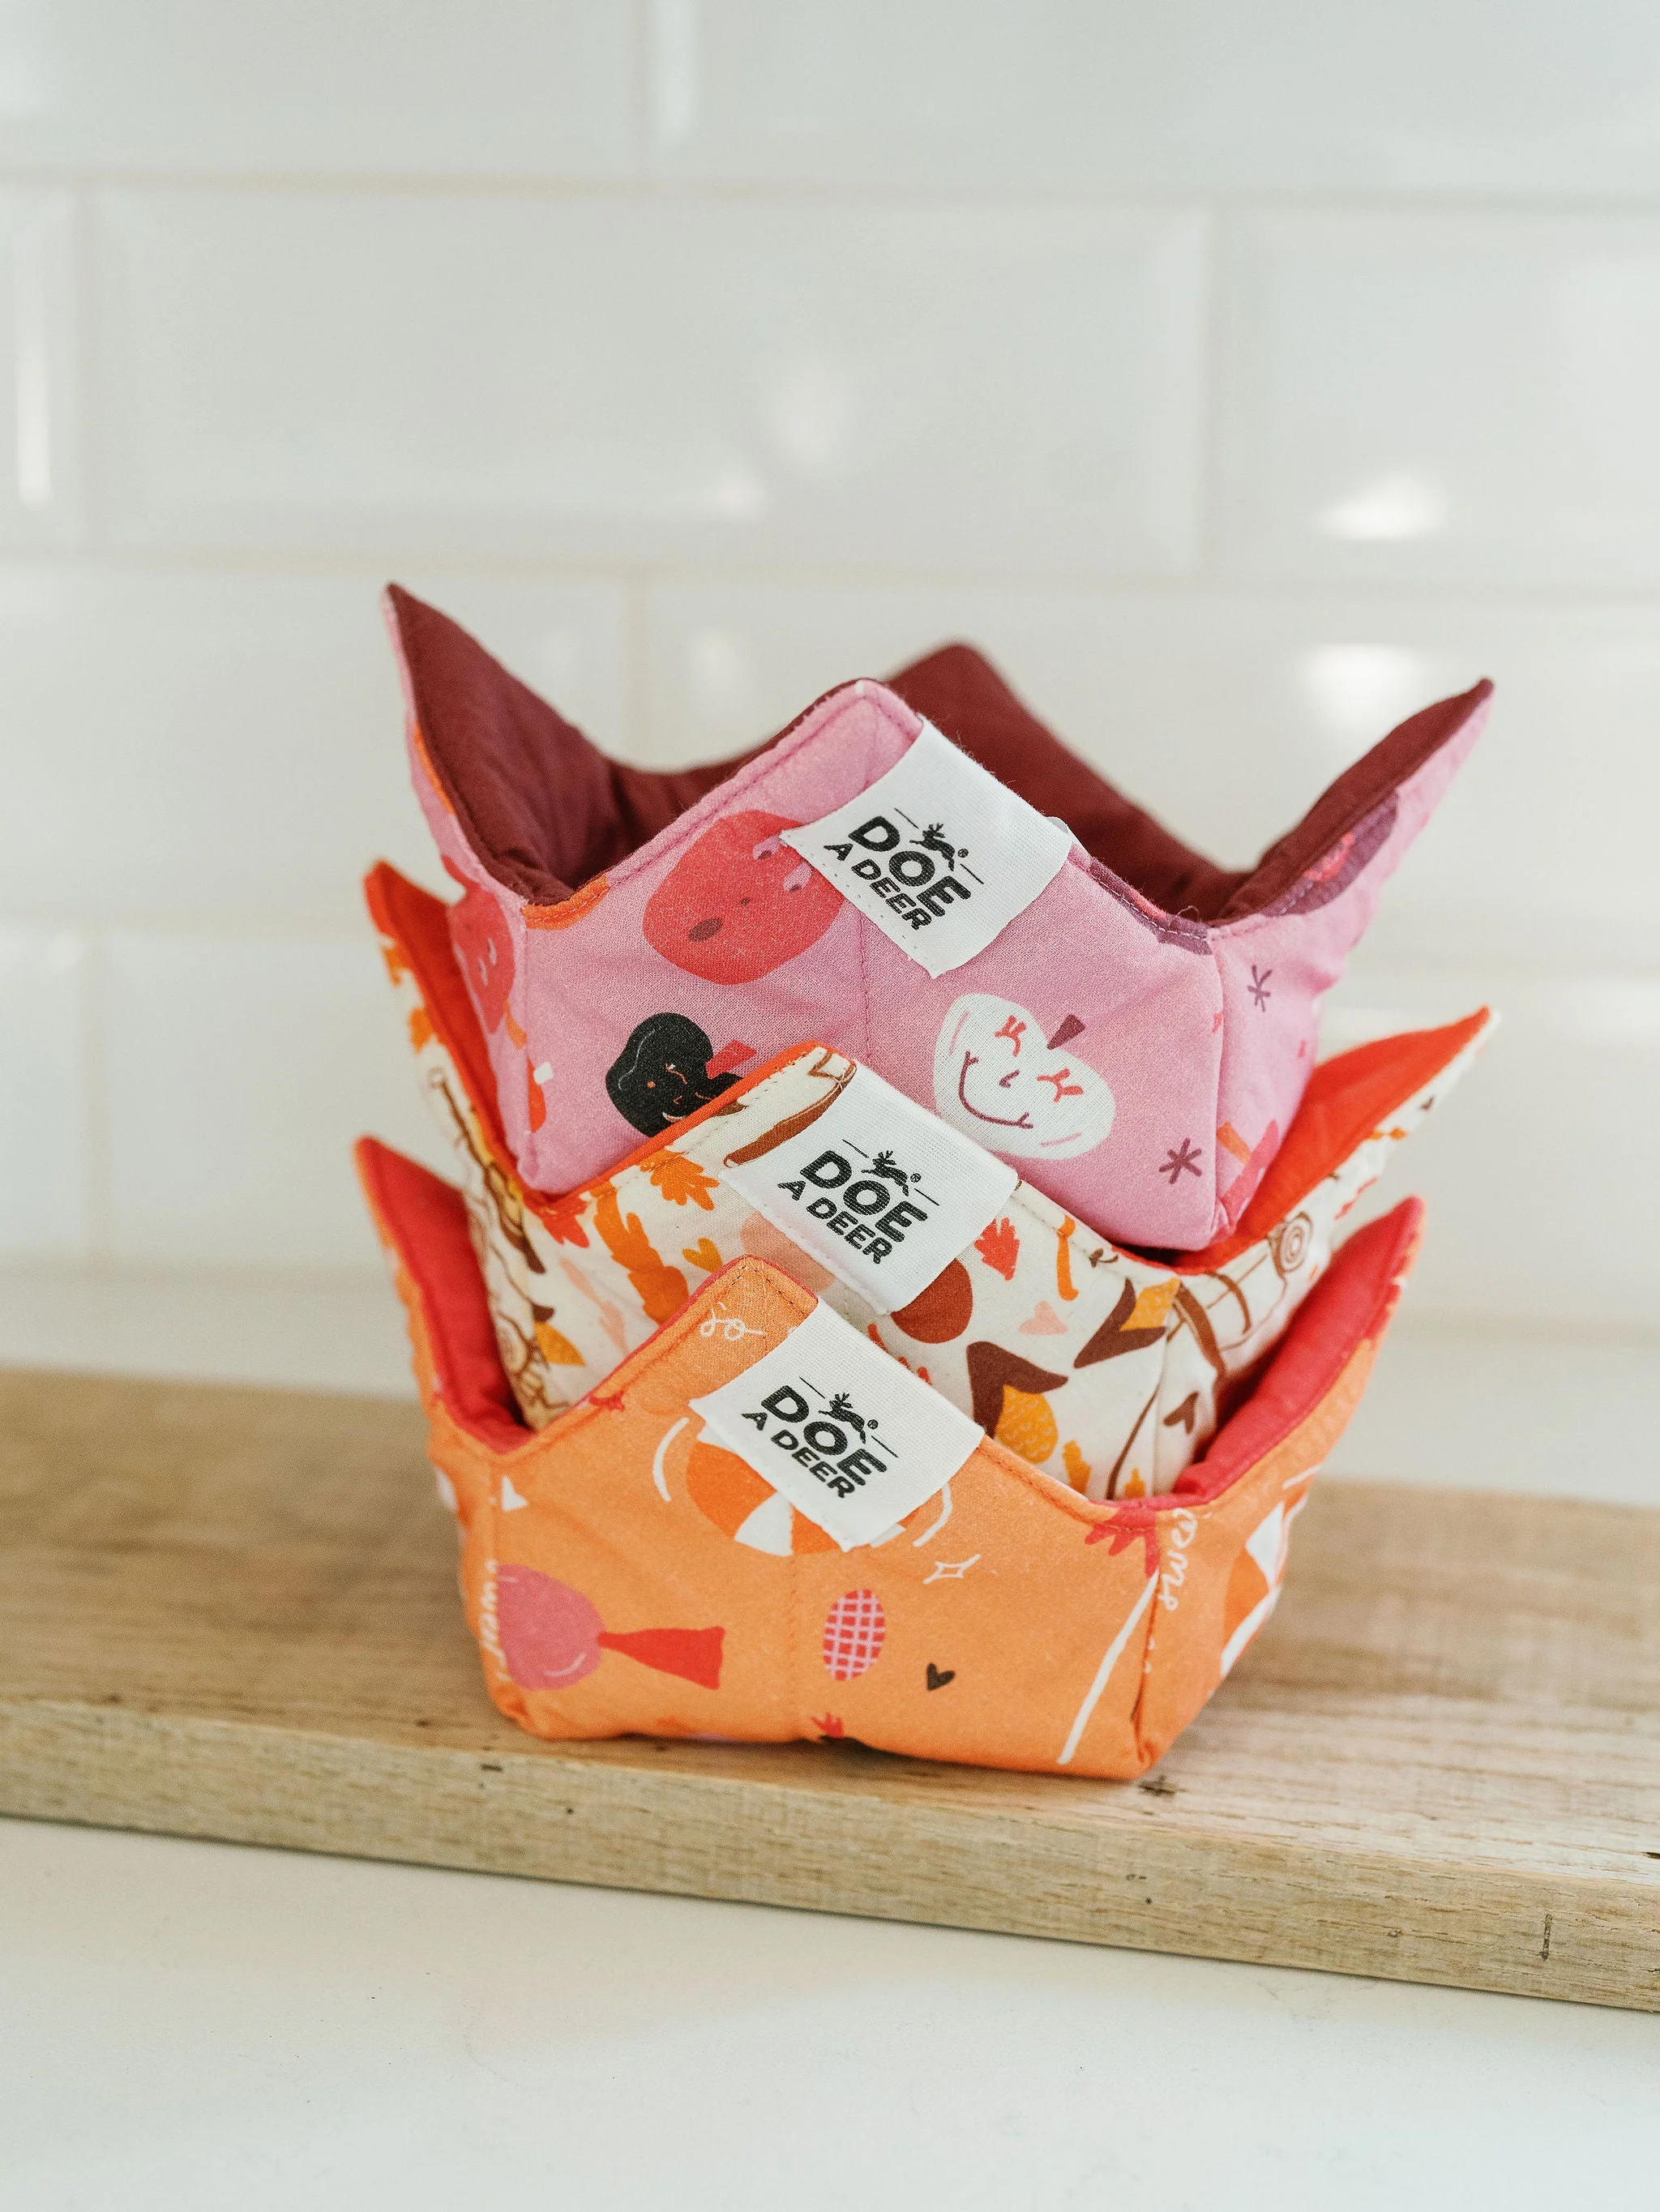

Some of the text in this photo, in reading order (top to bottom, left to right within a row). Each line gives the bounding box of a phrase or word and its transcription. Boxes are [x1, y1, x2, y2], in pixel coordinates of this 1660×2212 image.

[824, 843, 932, 931] A DEER
[849, 815, 971, 917] DOE
[777, 1180, 892, 1264] A DEER
[799, 1150, 928, 1243] DOE
[742, 1412, 854, 1498] A DEER
[761, 1385, 887, 1486] DOE
